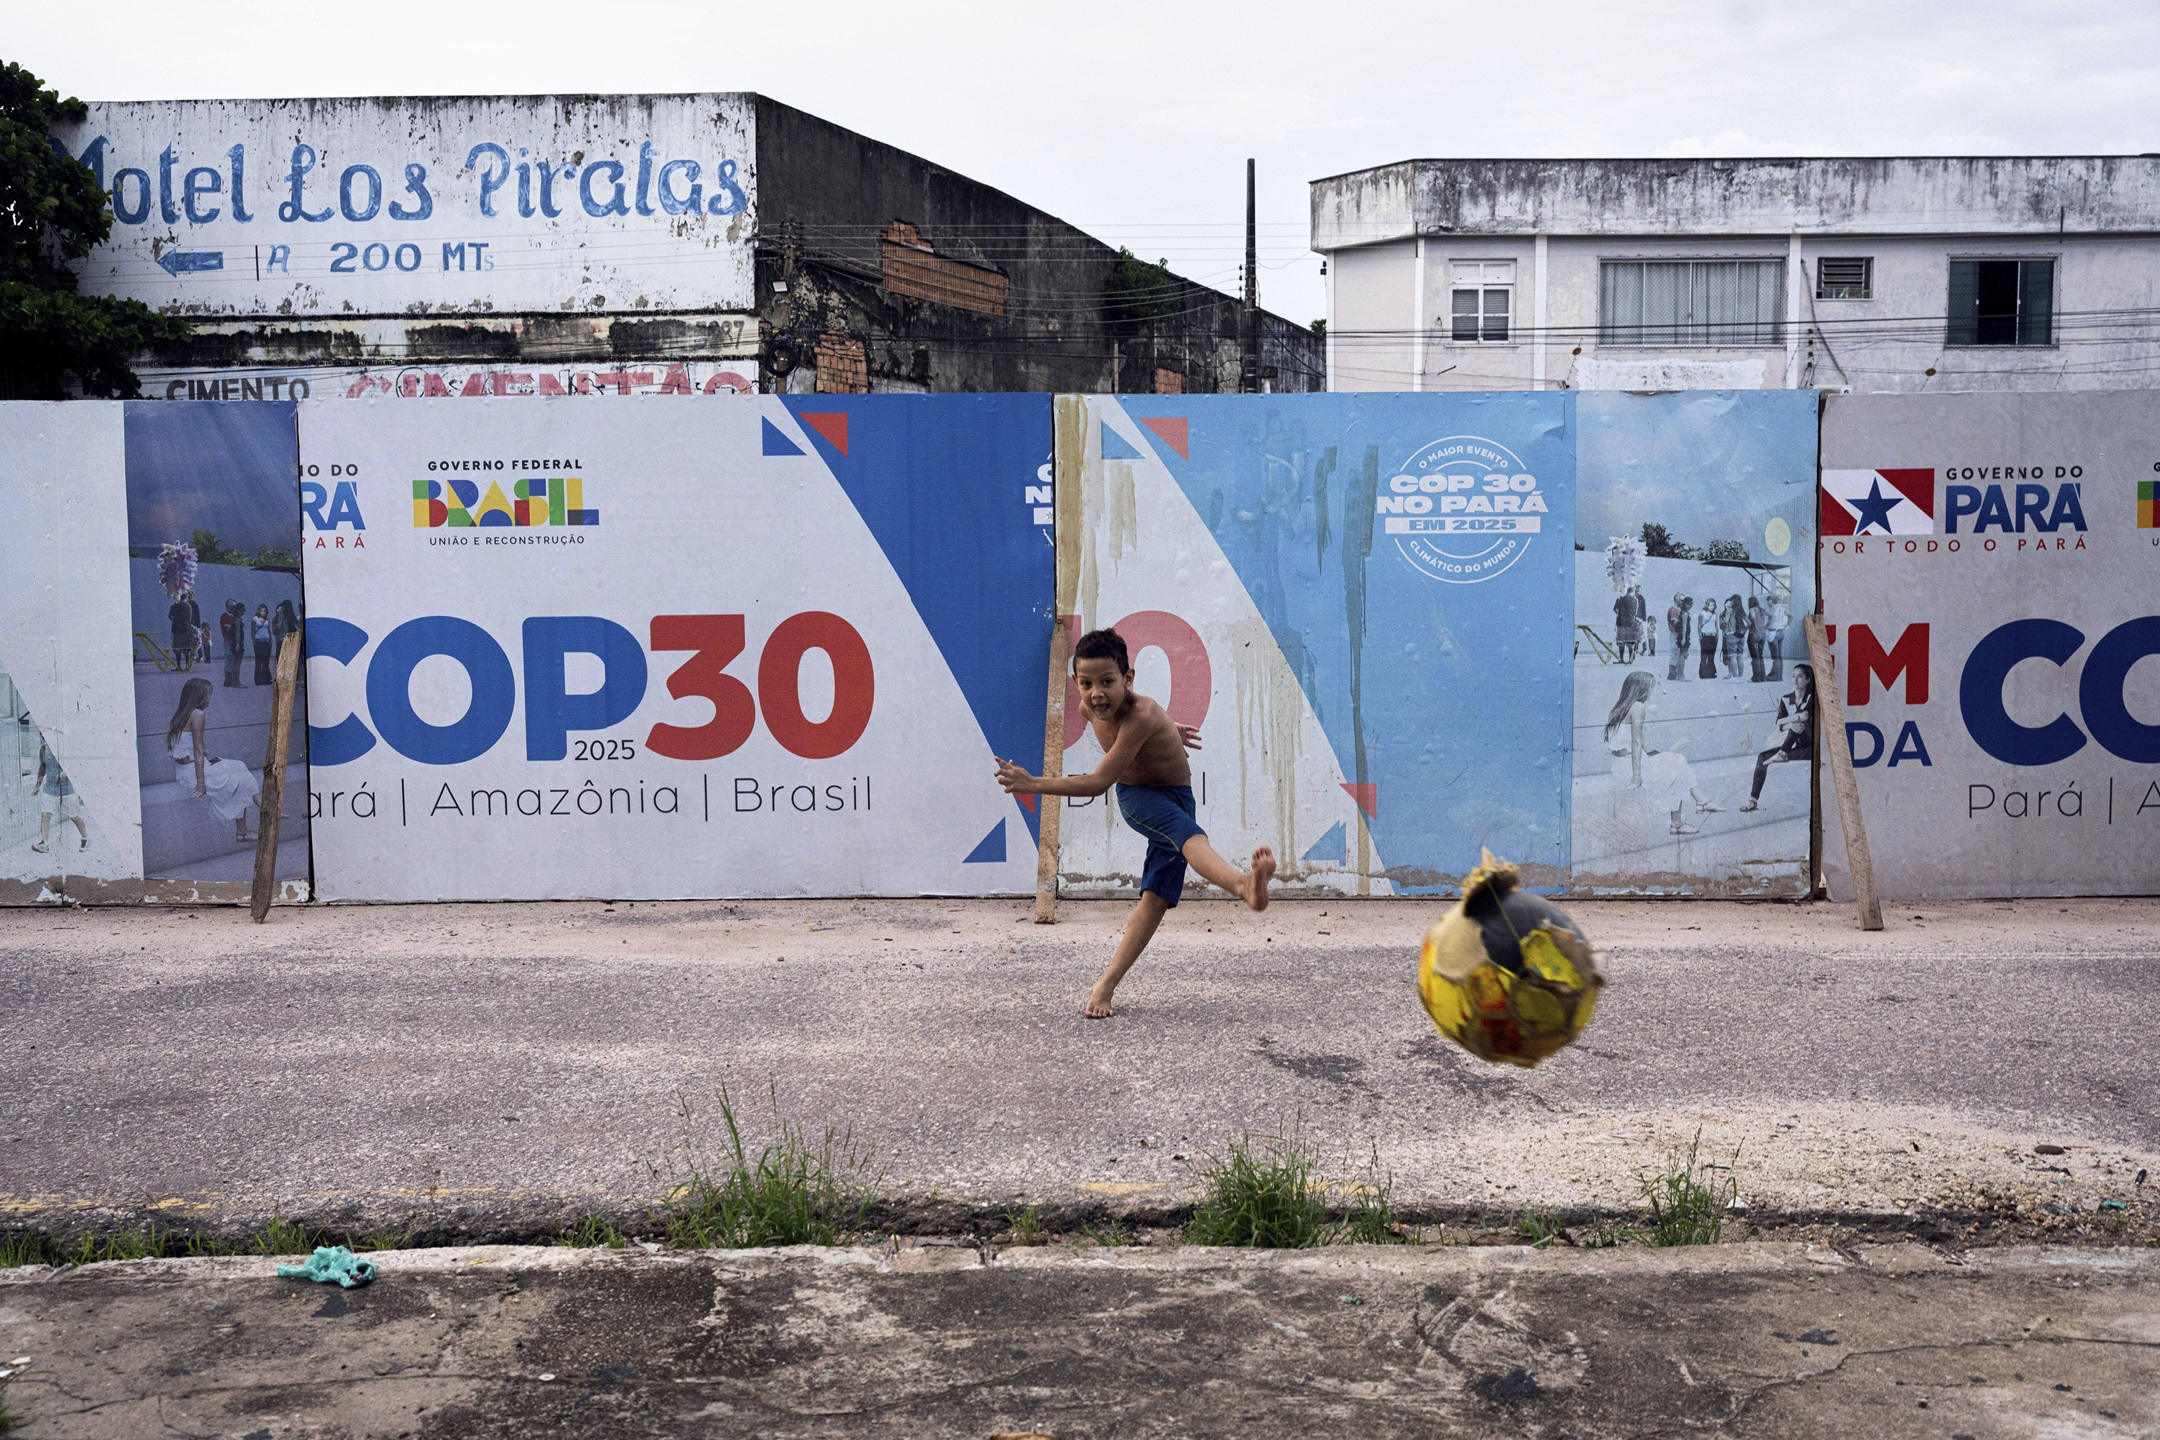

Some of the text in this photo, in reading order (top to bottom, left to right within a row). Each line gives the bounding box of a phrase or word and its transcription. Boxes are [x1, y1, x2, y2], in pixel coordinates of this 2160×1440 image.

[464, 140, 748, 219] Piratas
[330, 242, 422, 273] 200
[166, 377, 310, 400] CIMENTO
[428, 459, 583, 471] GOVERNO FEDERAL
[1419, 445, 1508, 469] O MAIOR EVENTO
[300, 464, 358, 476] O DO
[1946, 465, 2083, 480] GOVERNO DO
[1390, 473, 1536, 493] COP 30
[412, 478, 600, 528] BRASIL
[1377, 490, 1549, 514] NO PARÁ
[1409, 519, 1517, 531] EM 2025
[429, 533, 585, 546] UNIÃO E RECONSTRUÇÃO
[1886, 540, 1961, 553] TODO
[1984, 539, 1996, 551] O
[2018, 535, 2087, 551] PARÁ
[1410, 540, 1516, 574] CLIMÁTICO DO MUNDO
[305, 611, 875, 766] COP30
[574, 739, 636, 761] 2025
[430, 779, 678, 816] Amazônia
[734, 776, 871, 812] Brasil
[1969, 781, 2082, 818] Pará
